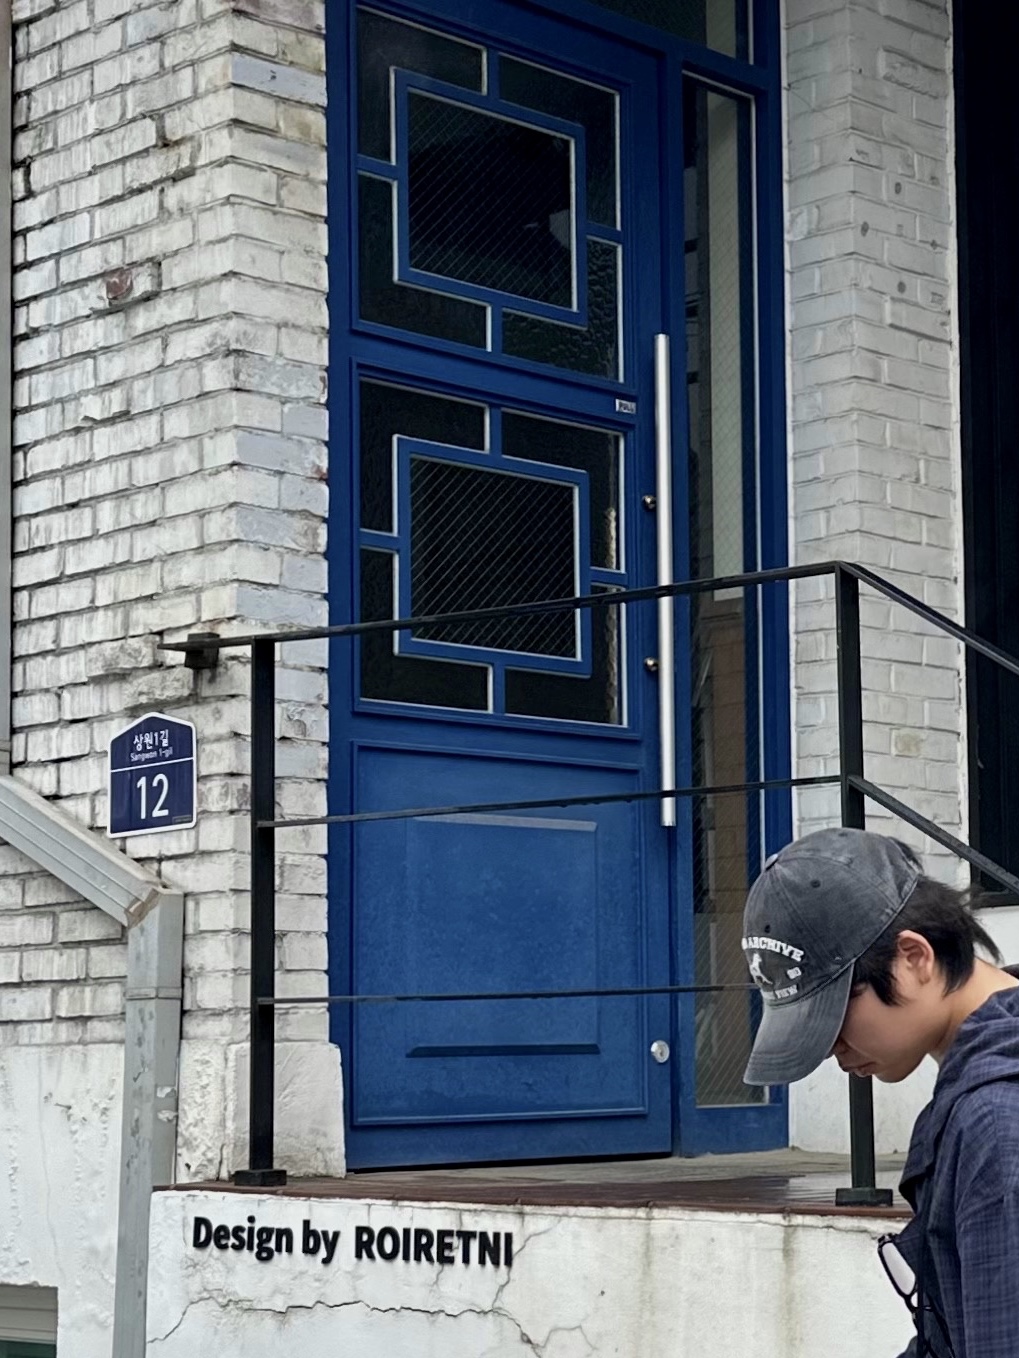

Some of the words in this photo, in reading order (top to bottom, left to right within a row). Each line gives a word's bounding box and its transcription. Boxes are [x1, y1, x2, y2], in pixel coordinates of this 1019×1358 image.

[133, 729, 168, 751] 상원1길
[136, 773, 169, 820] 12
[192, 1215, 293, 1261] Design
[302, 1219, 341, 1264] by
[354, 1225, 514, 1267] ROIRETNI
